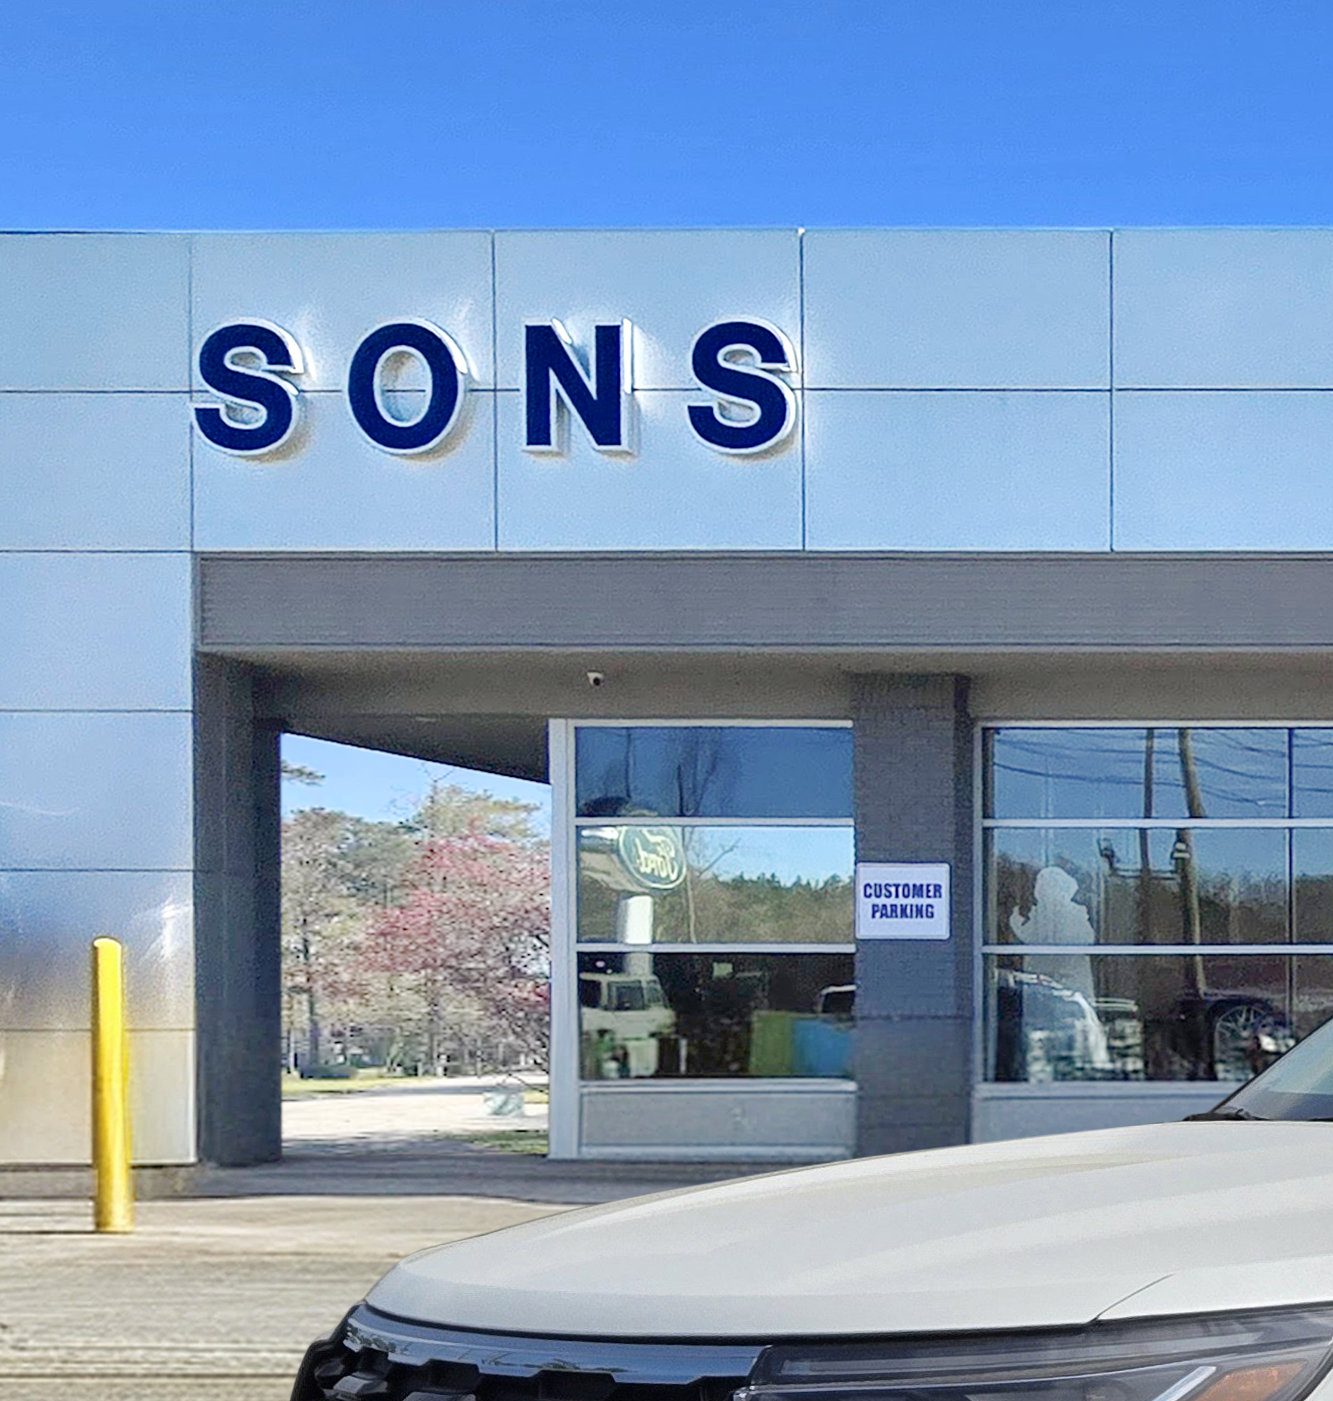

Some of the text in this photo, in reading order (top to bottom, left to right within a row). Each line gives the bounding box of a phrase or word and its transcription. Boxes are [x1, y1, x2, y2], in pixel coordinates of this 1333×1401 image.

[195, 321, 797, 454] SONS
[863, 883, 942, 899] CUSTOMER
[871, 904, 934, 919] PARKING
